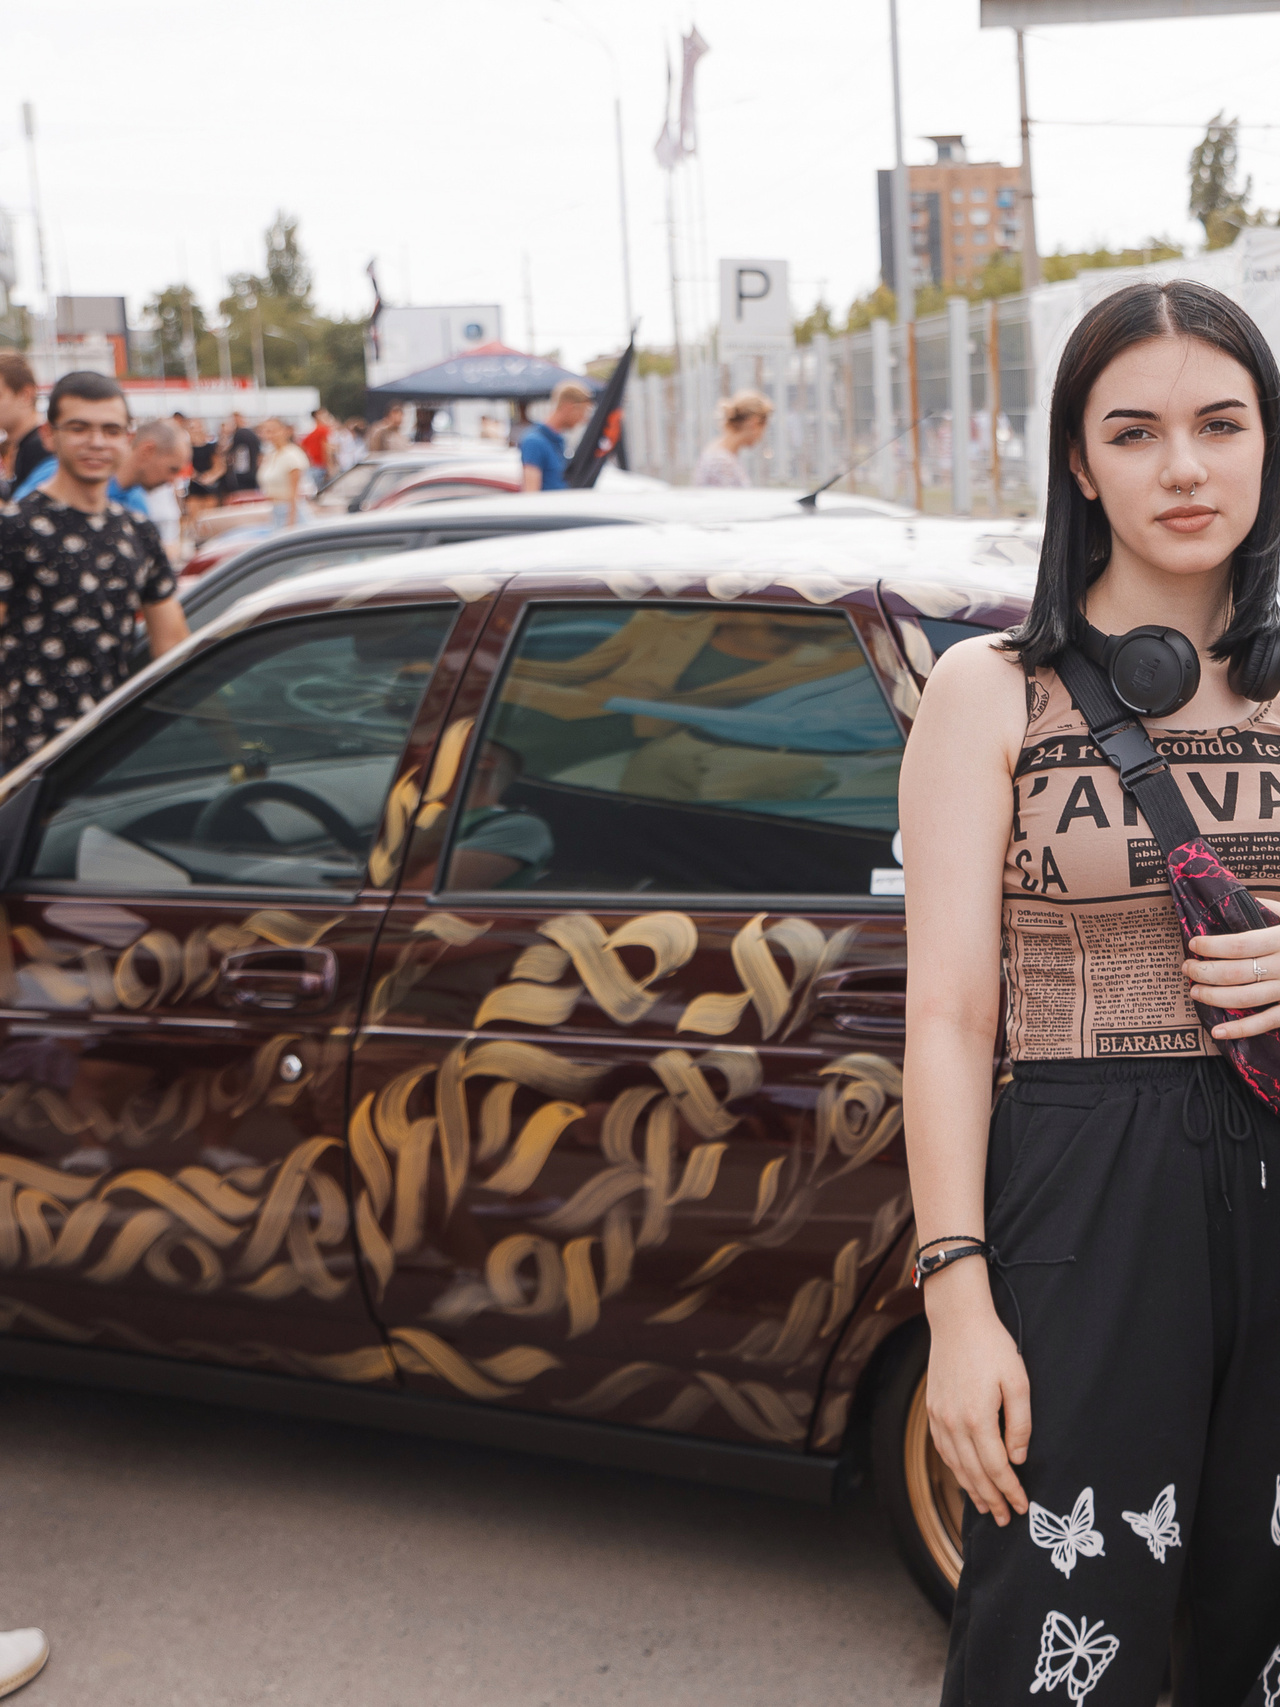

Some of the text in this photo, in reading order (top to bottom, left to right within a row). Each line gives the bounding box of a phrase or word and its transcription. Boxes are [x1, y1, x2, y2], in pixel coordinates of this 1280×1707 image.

[736, 267, 770, 322] P
[1030, 743, 1066, 766] 24
[1099, 1032, 1196, 1053] BLARARAS
